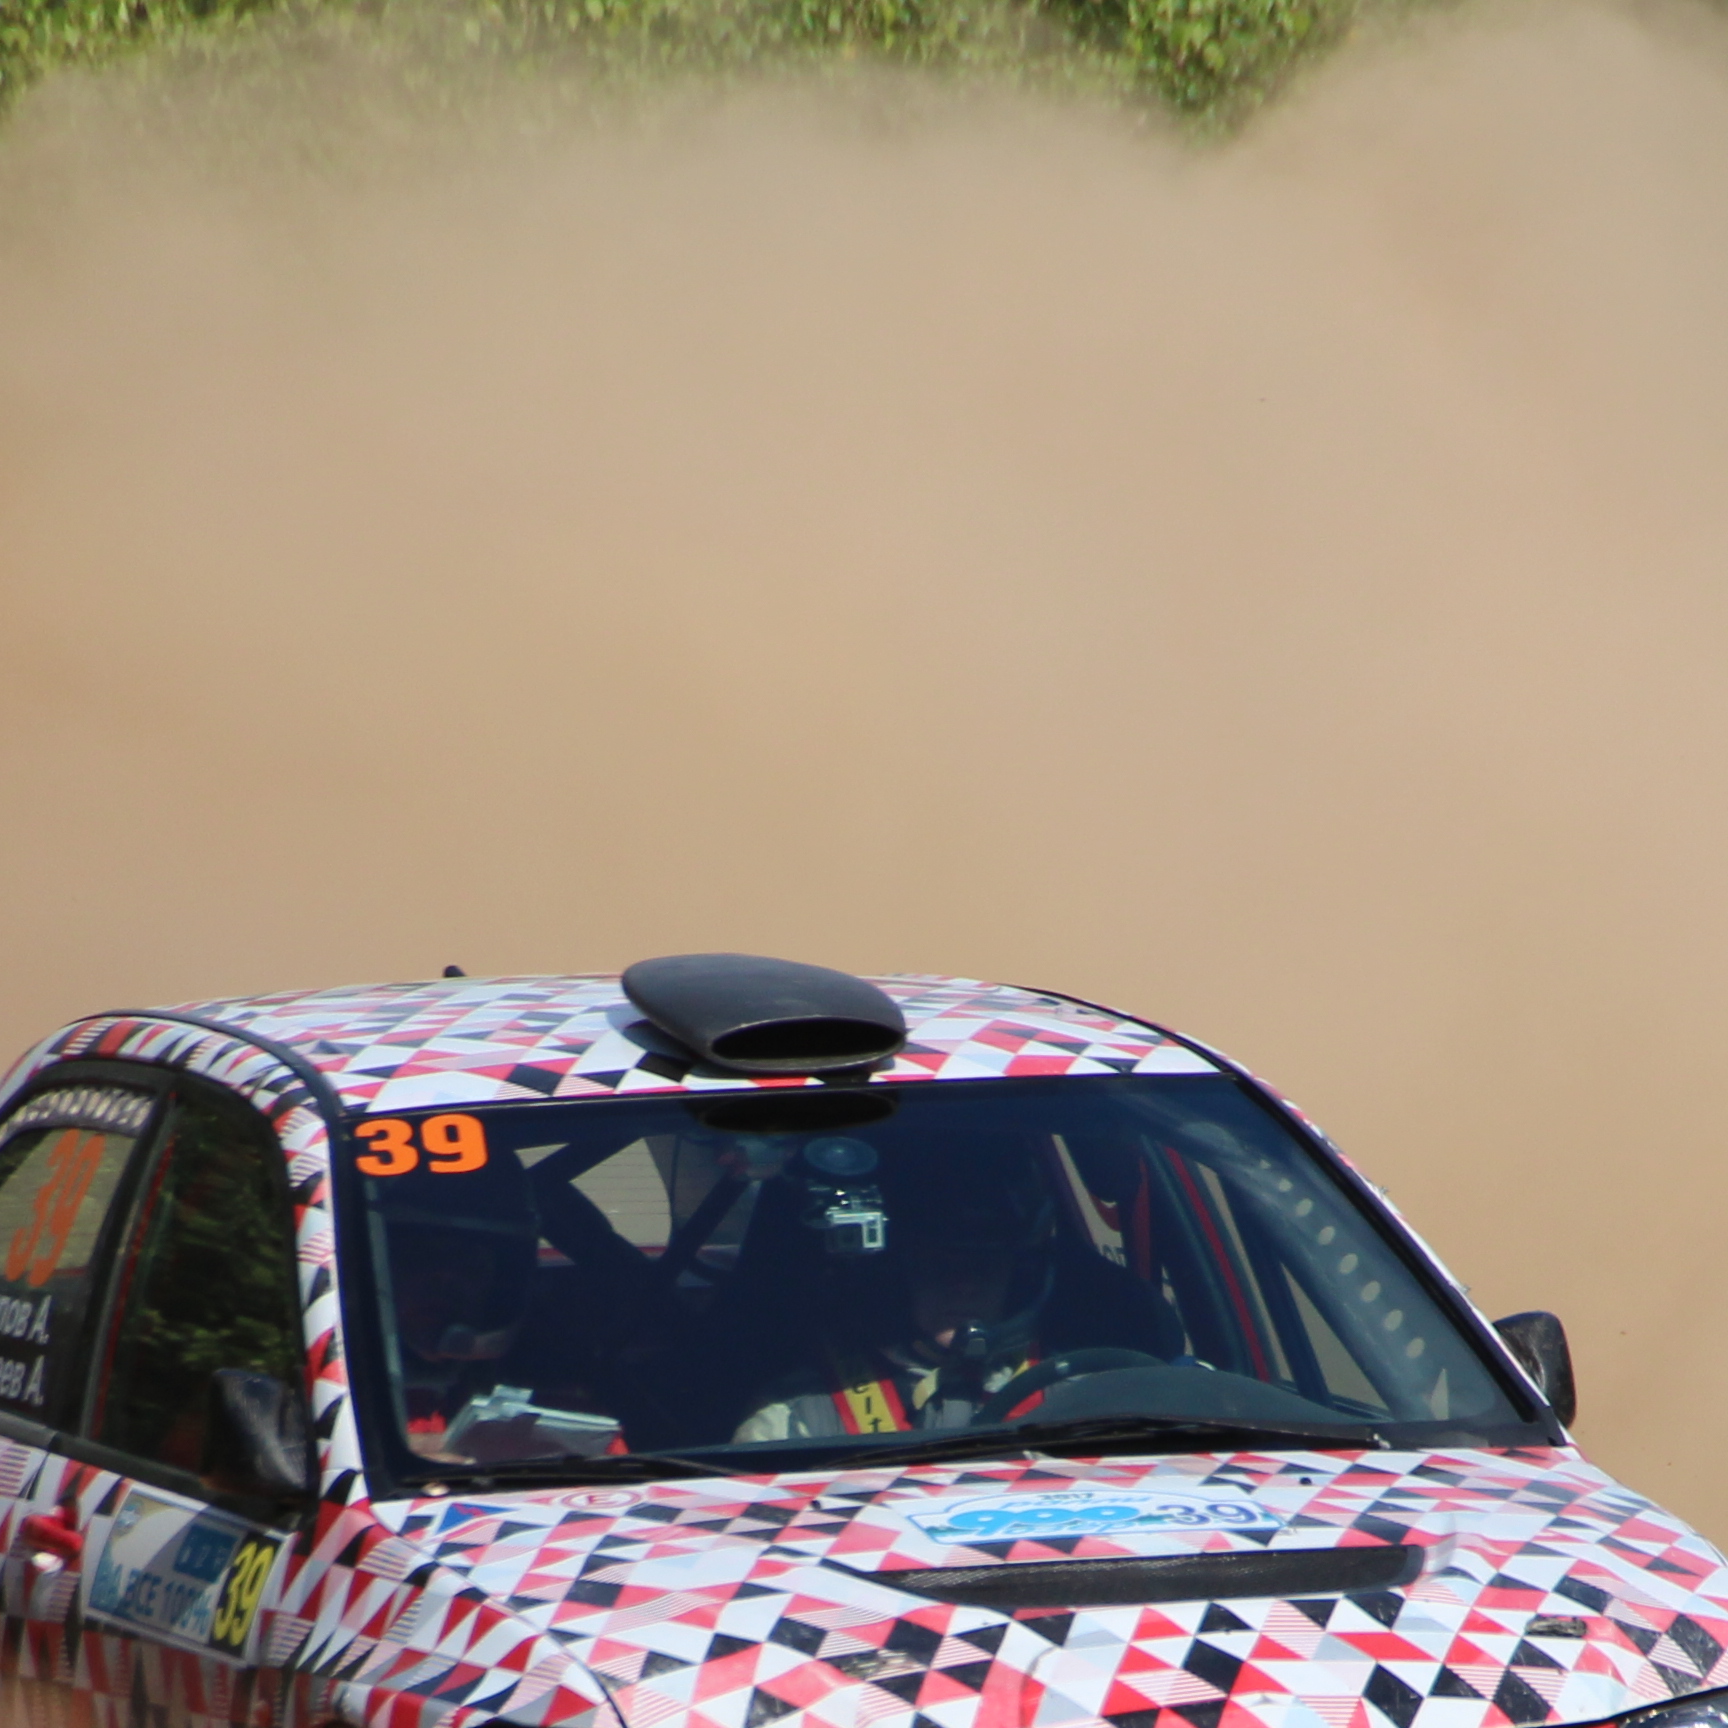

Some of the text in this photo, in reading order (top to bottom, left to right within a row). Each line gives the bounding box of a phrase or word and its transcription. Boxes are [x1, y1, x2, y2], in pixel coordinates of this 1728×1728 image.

[355, 1113, 488, 1176] 39
[4, 1129, 106, 1287] 39
[950, 1506, 1139, 1537] 900
[1157, 1504, 1259, 1525] 39
[214, 1542, 274, 1646] 39
